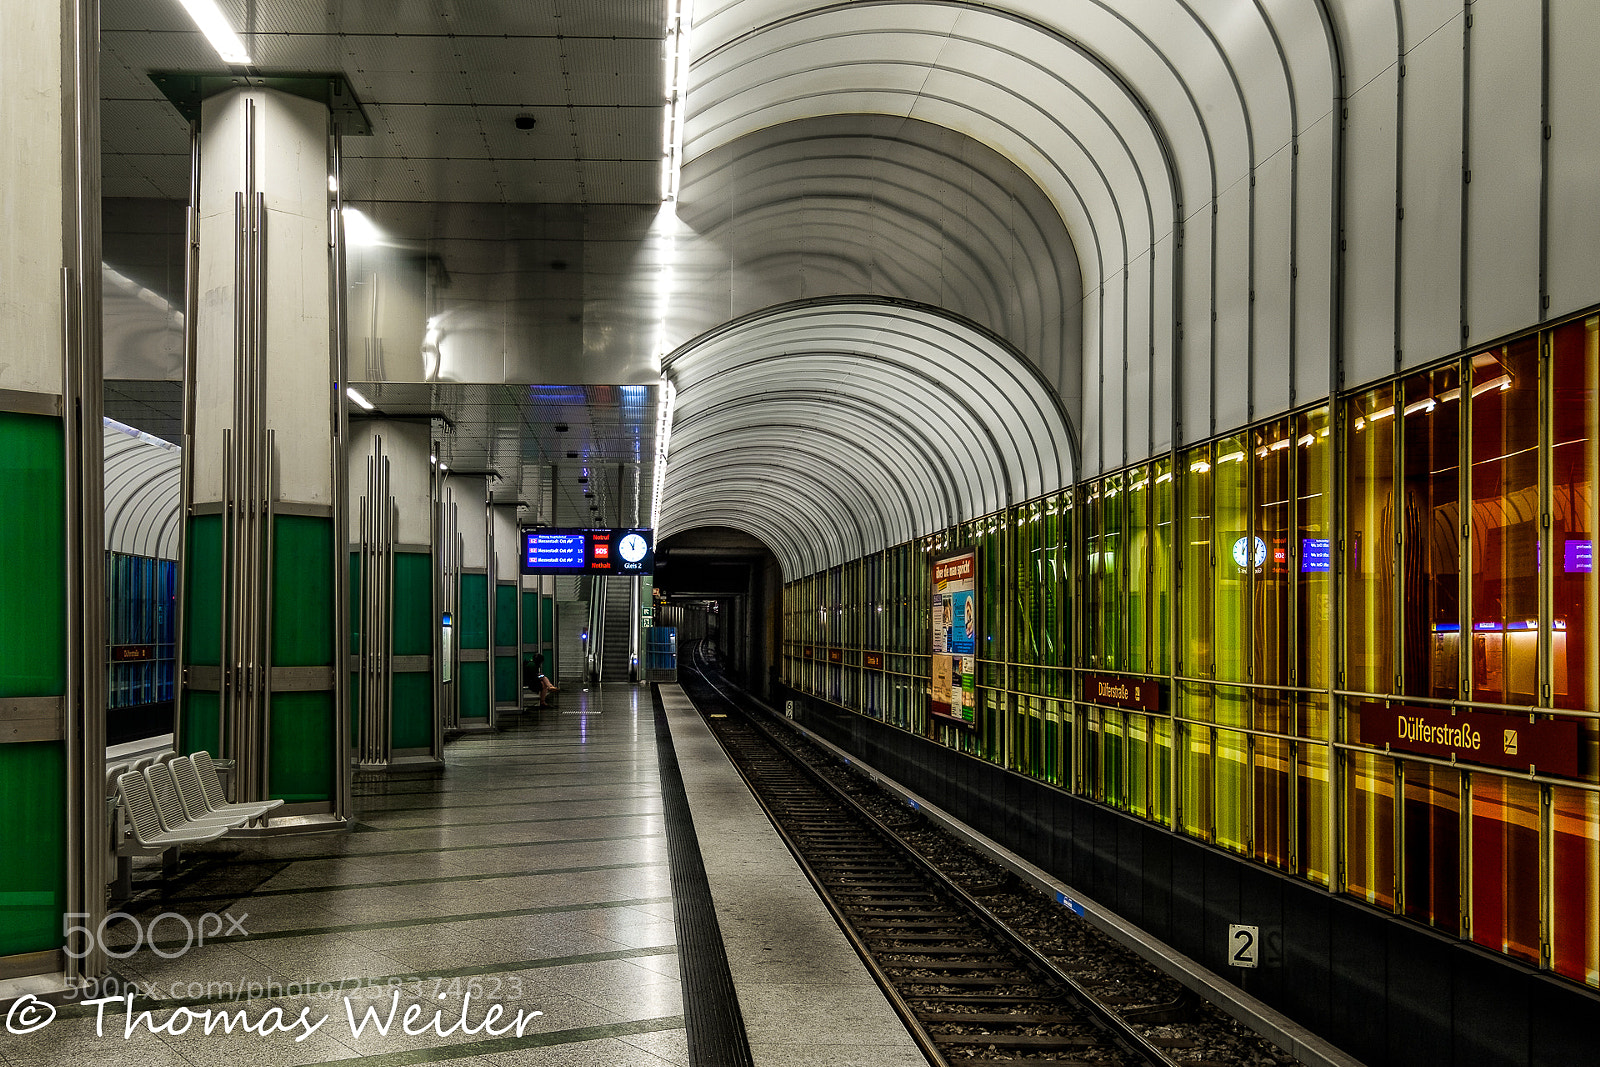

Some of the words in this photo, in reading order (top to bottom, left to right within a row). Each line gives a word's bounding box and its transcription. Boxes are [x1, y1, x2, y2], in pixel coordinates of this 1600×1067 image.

[1098, 681, 1129, 700] Dülferstraße
[1397, 714, 1482, 751] Dülferstraße
[1234, 930, 1254, 963] 2
